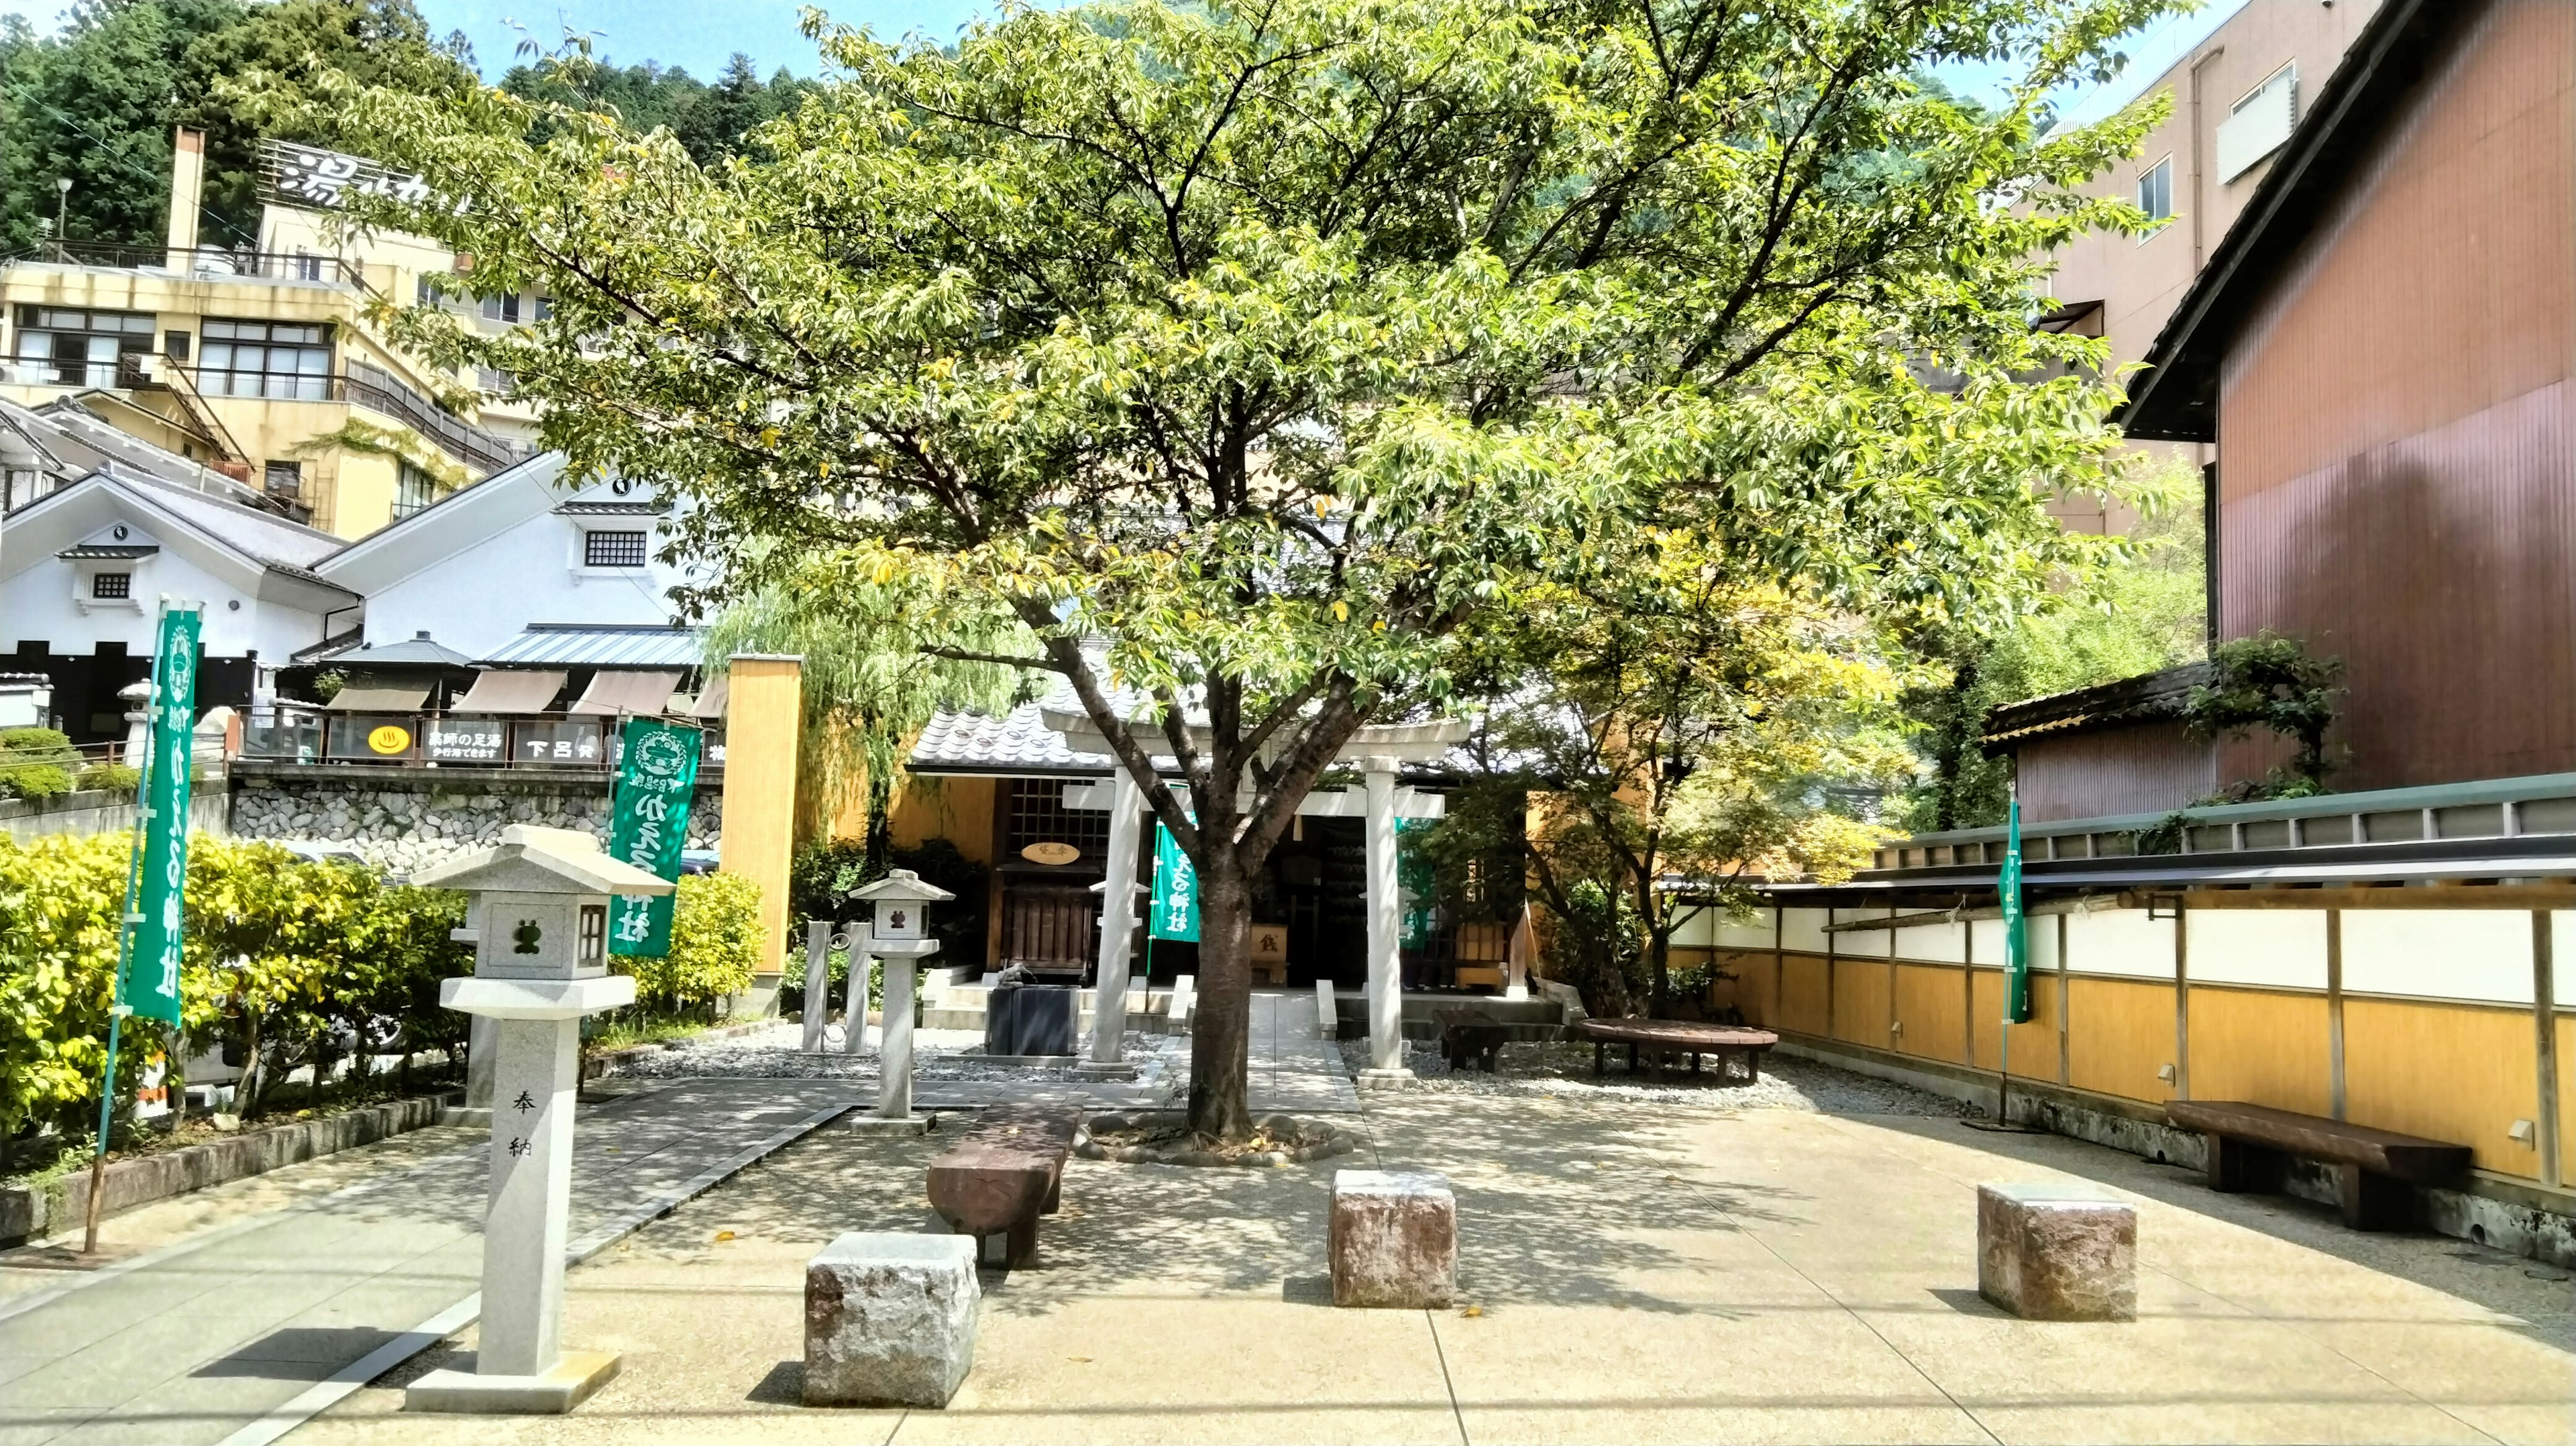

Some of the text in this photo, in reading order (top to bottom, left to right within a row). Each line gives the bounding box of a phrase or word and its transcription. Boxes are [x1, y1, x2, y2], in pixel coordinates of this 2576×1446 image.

[428, 732, 502, 748] 薬師の足湯
[508, 1090, 537, 1158] 奉納
